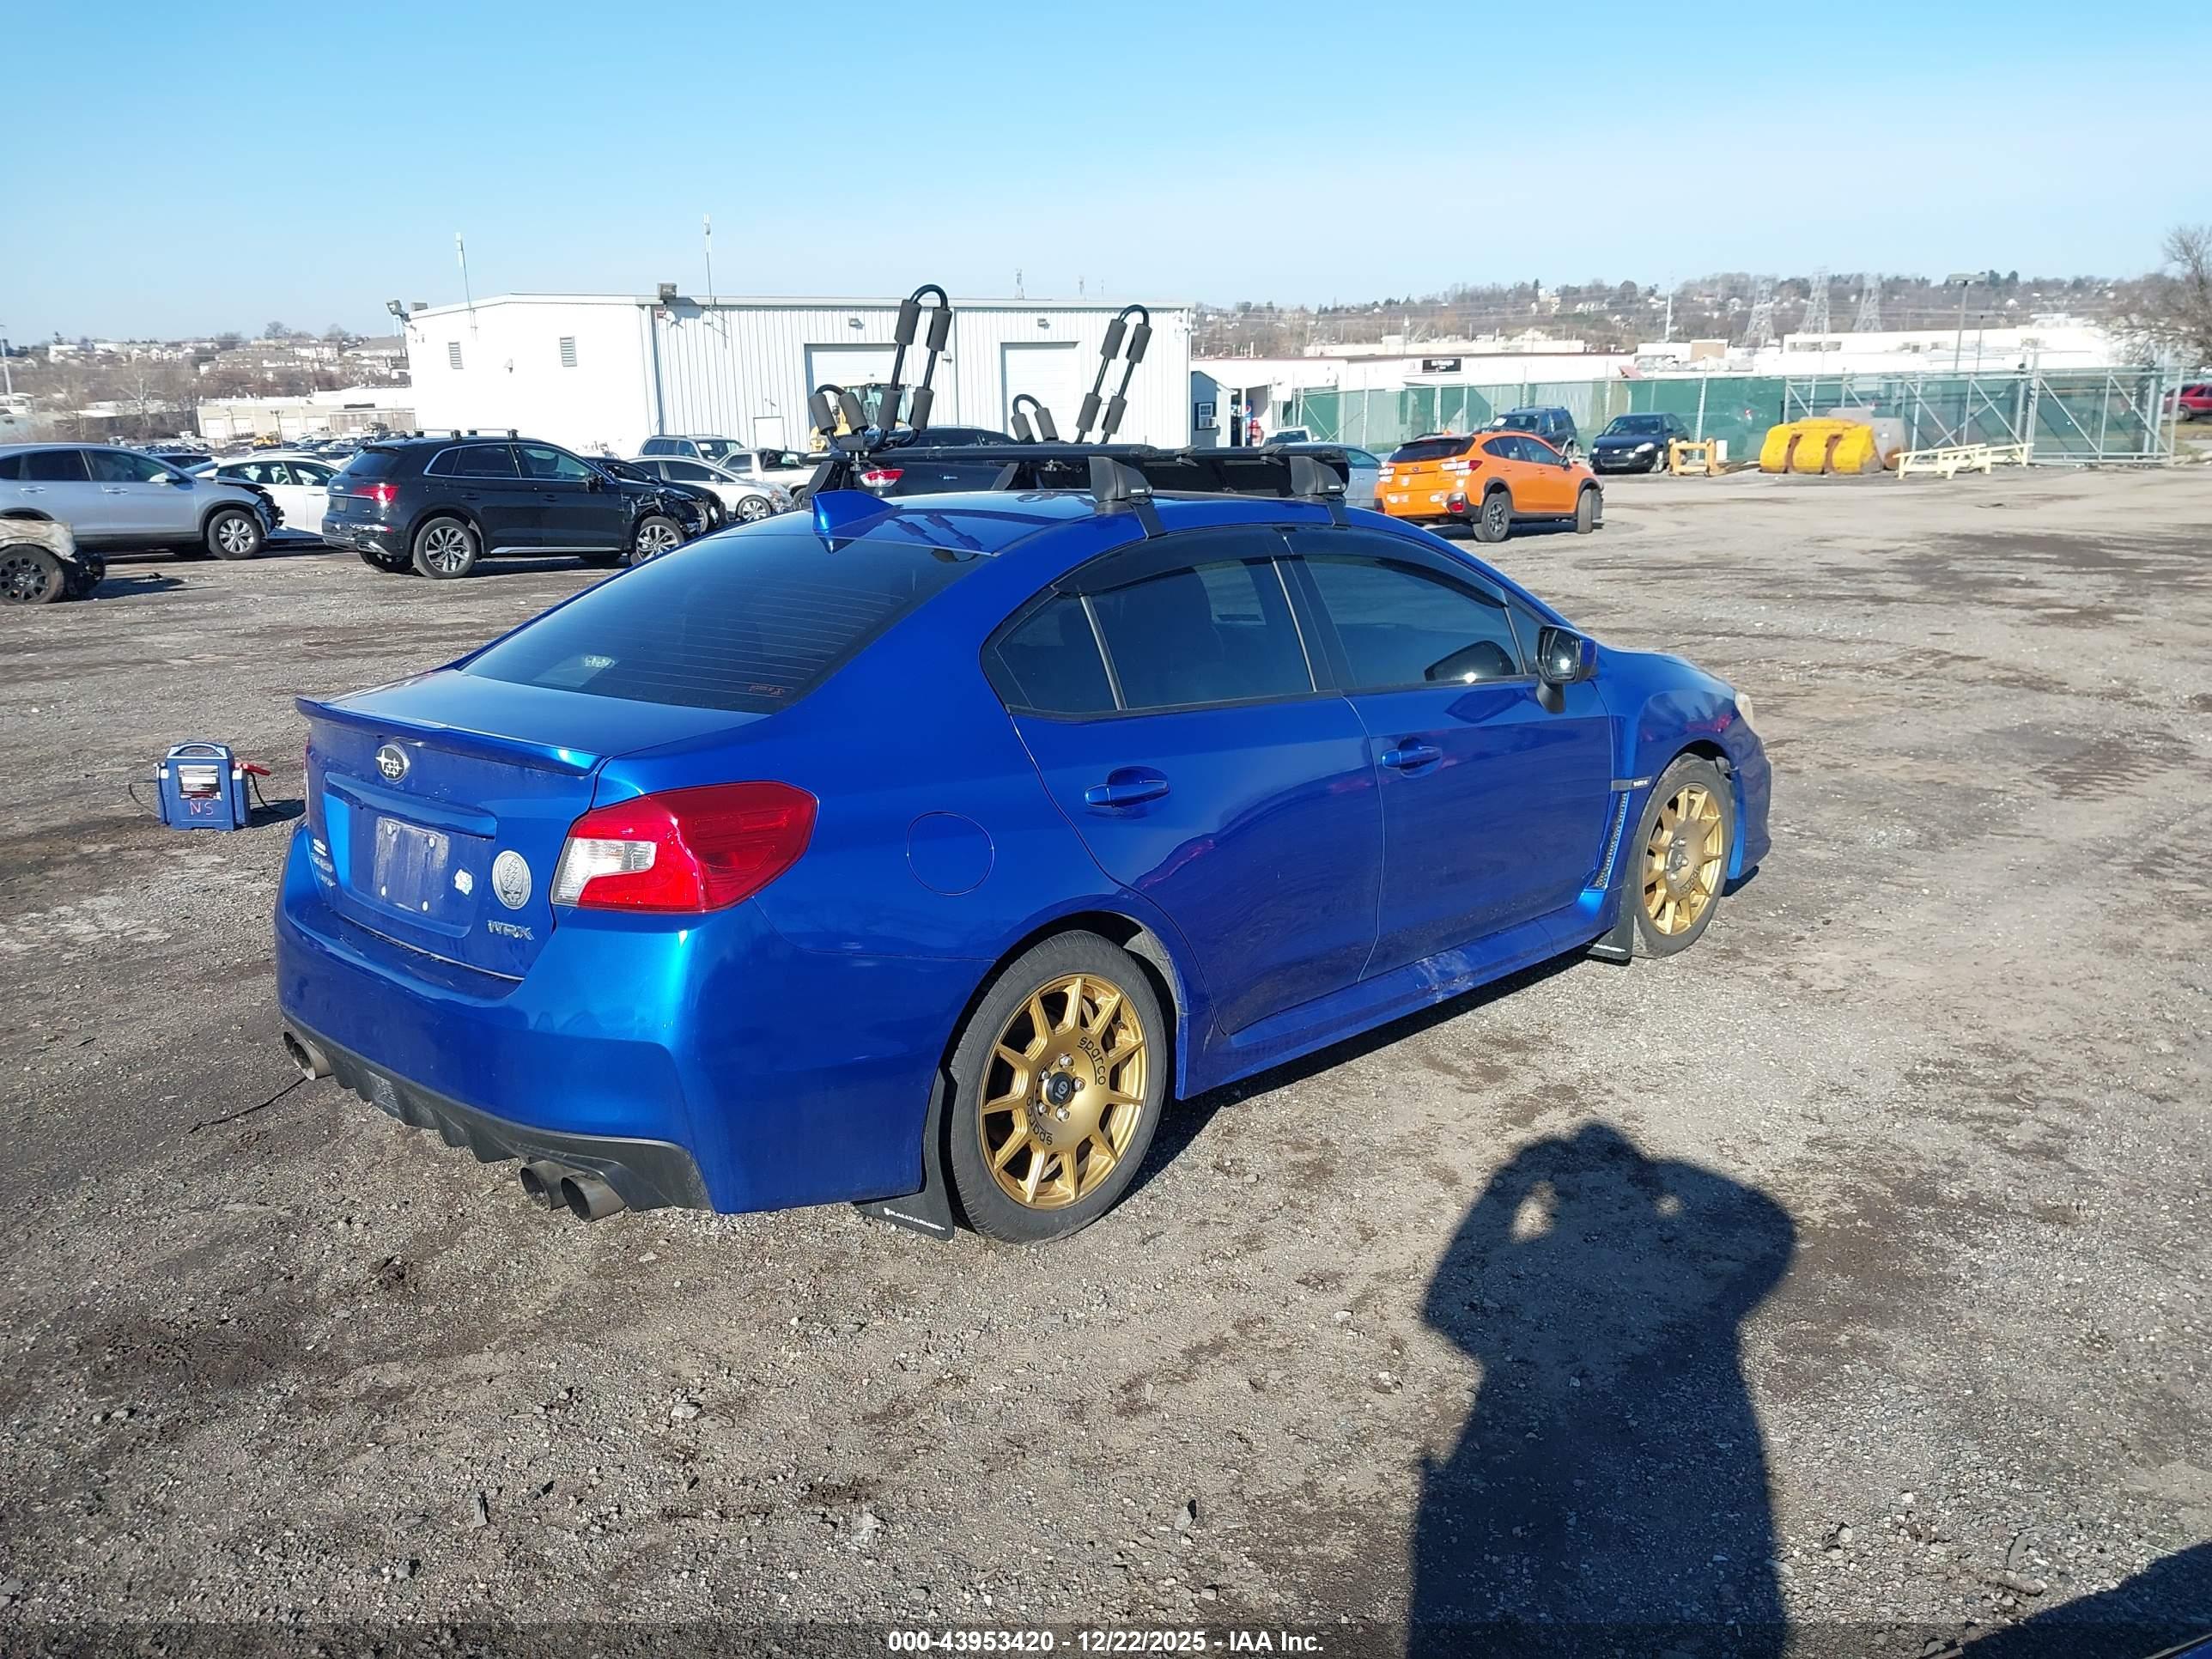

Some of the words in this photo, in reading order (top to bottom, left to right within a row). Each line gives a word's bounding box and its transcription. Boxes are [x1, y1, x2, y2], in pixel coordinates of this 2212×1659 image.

[487, 920, 535, 941] WRX
[1079, 1036, 1106, 1085] sparco
[1026, 1096, 1053, 1146] sparco
